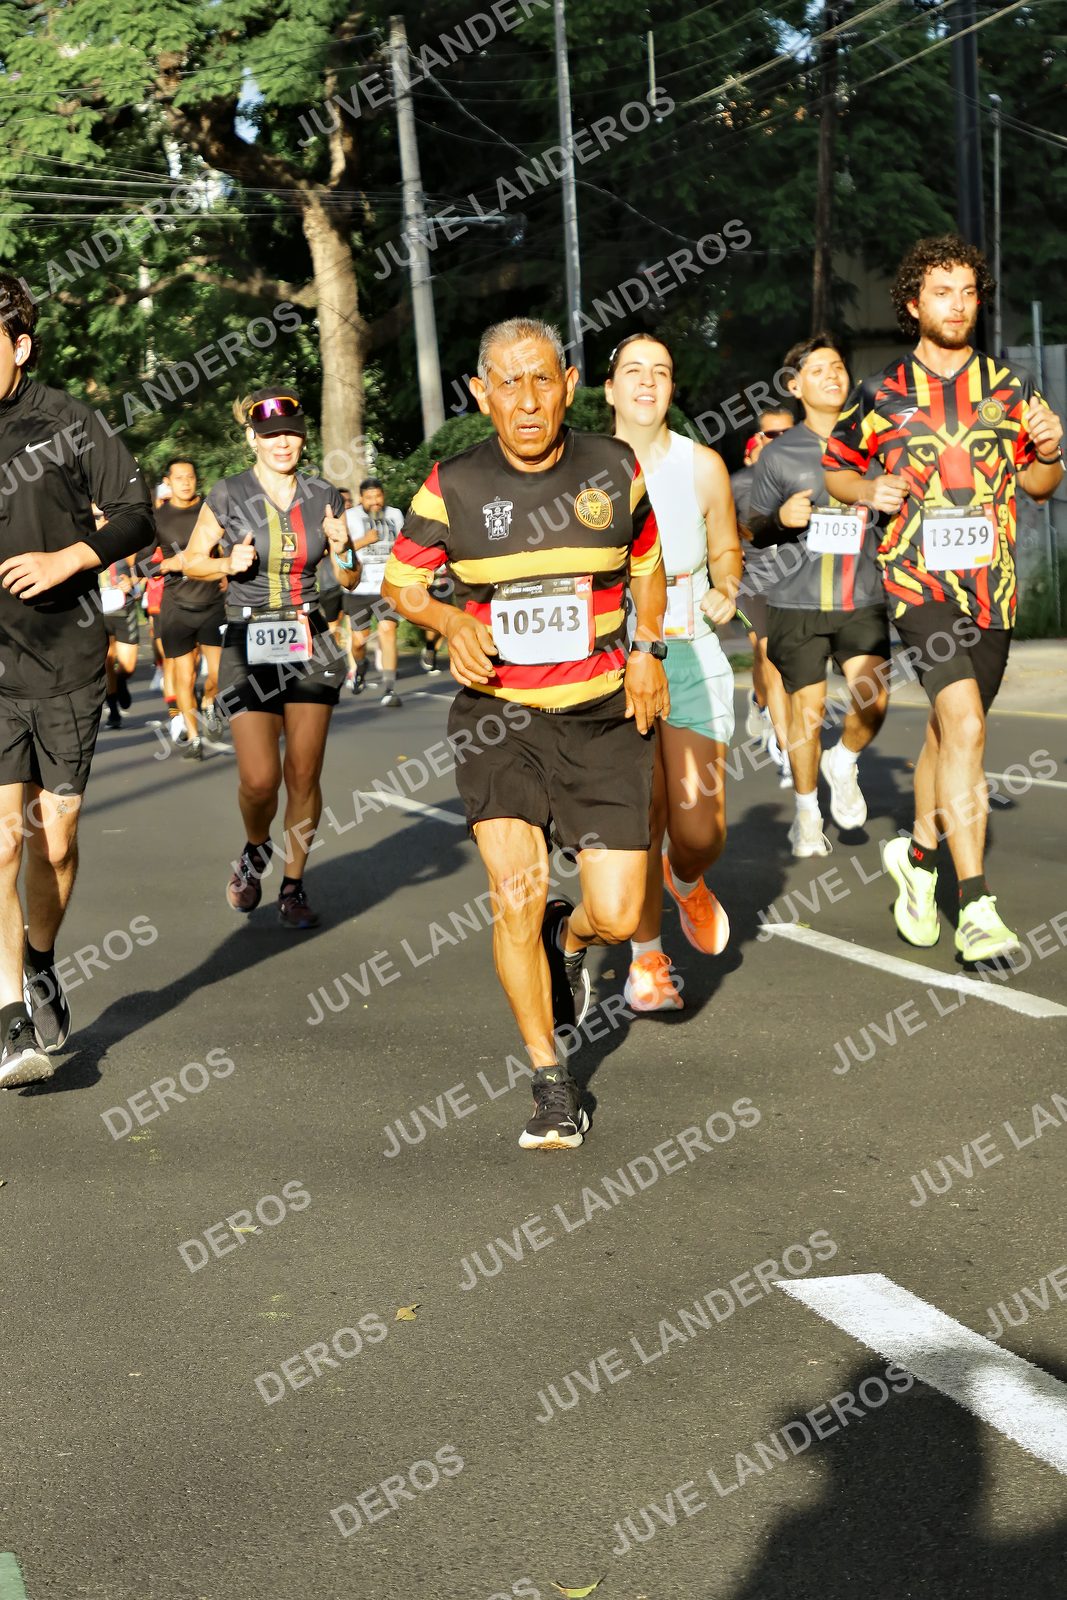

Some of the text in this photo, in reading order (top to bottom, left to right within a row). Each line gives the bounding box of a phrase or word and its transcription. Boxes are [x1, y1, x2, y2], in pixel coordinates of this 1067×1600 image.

[929, 525, 989, 547] 13259
[497, 606, 580, 635] 10543
[256, 627, 298, 646] 8192
